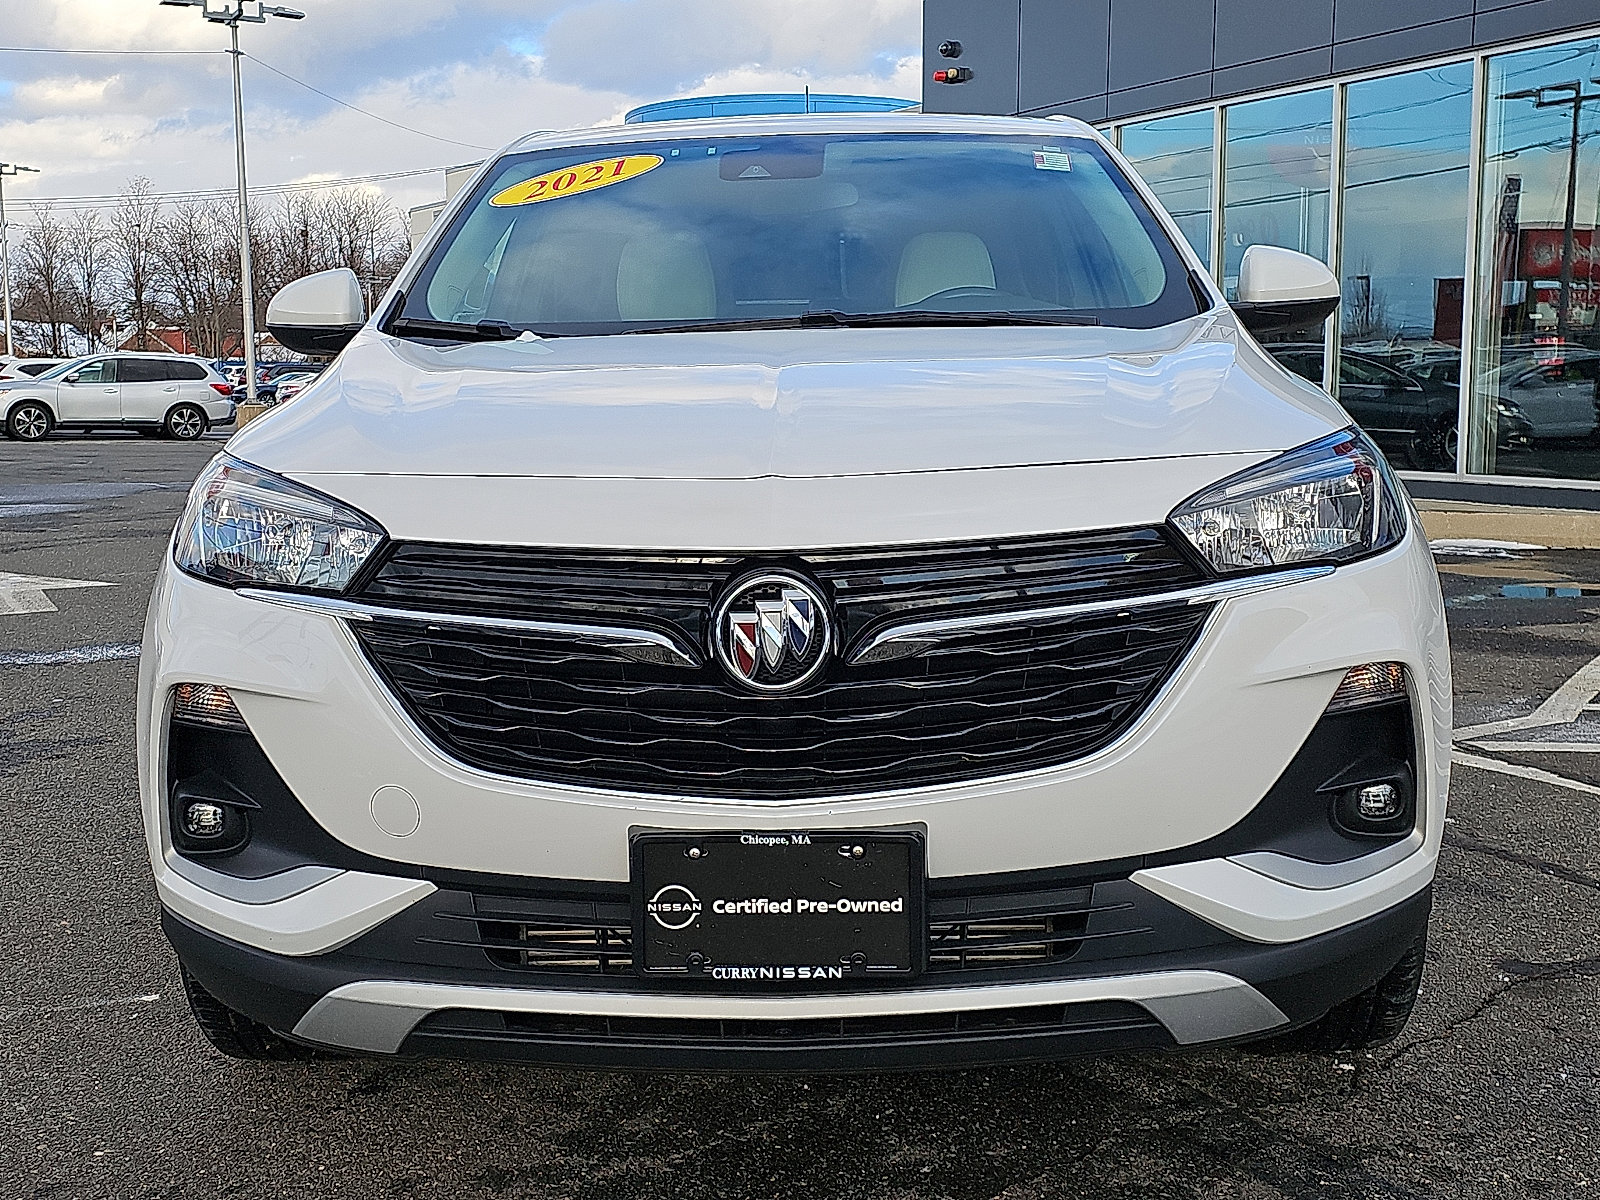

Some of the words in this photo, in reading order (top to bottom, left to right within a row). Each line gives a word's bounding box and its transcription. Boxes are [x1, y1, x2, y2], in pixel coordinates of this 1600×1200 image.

[522, 158, 627, 201] 2021
[740, 834, 790, 847] Chicopee,
[791, 834, 812, 845] MA
[647, 902, 702, 912] NISSAN
[712, 898, 792, 914] Certified
[796, 897, 903, 913] Pre-Owned
